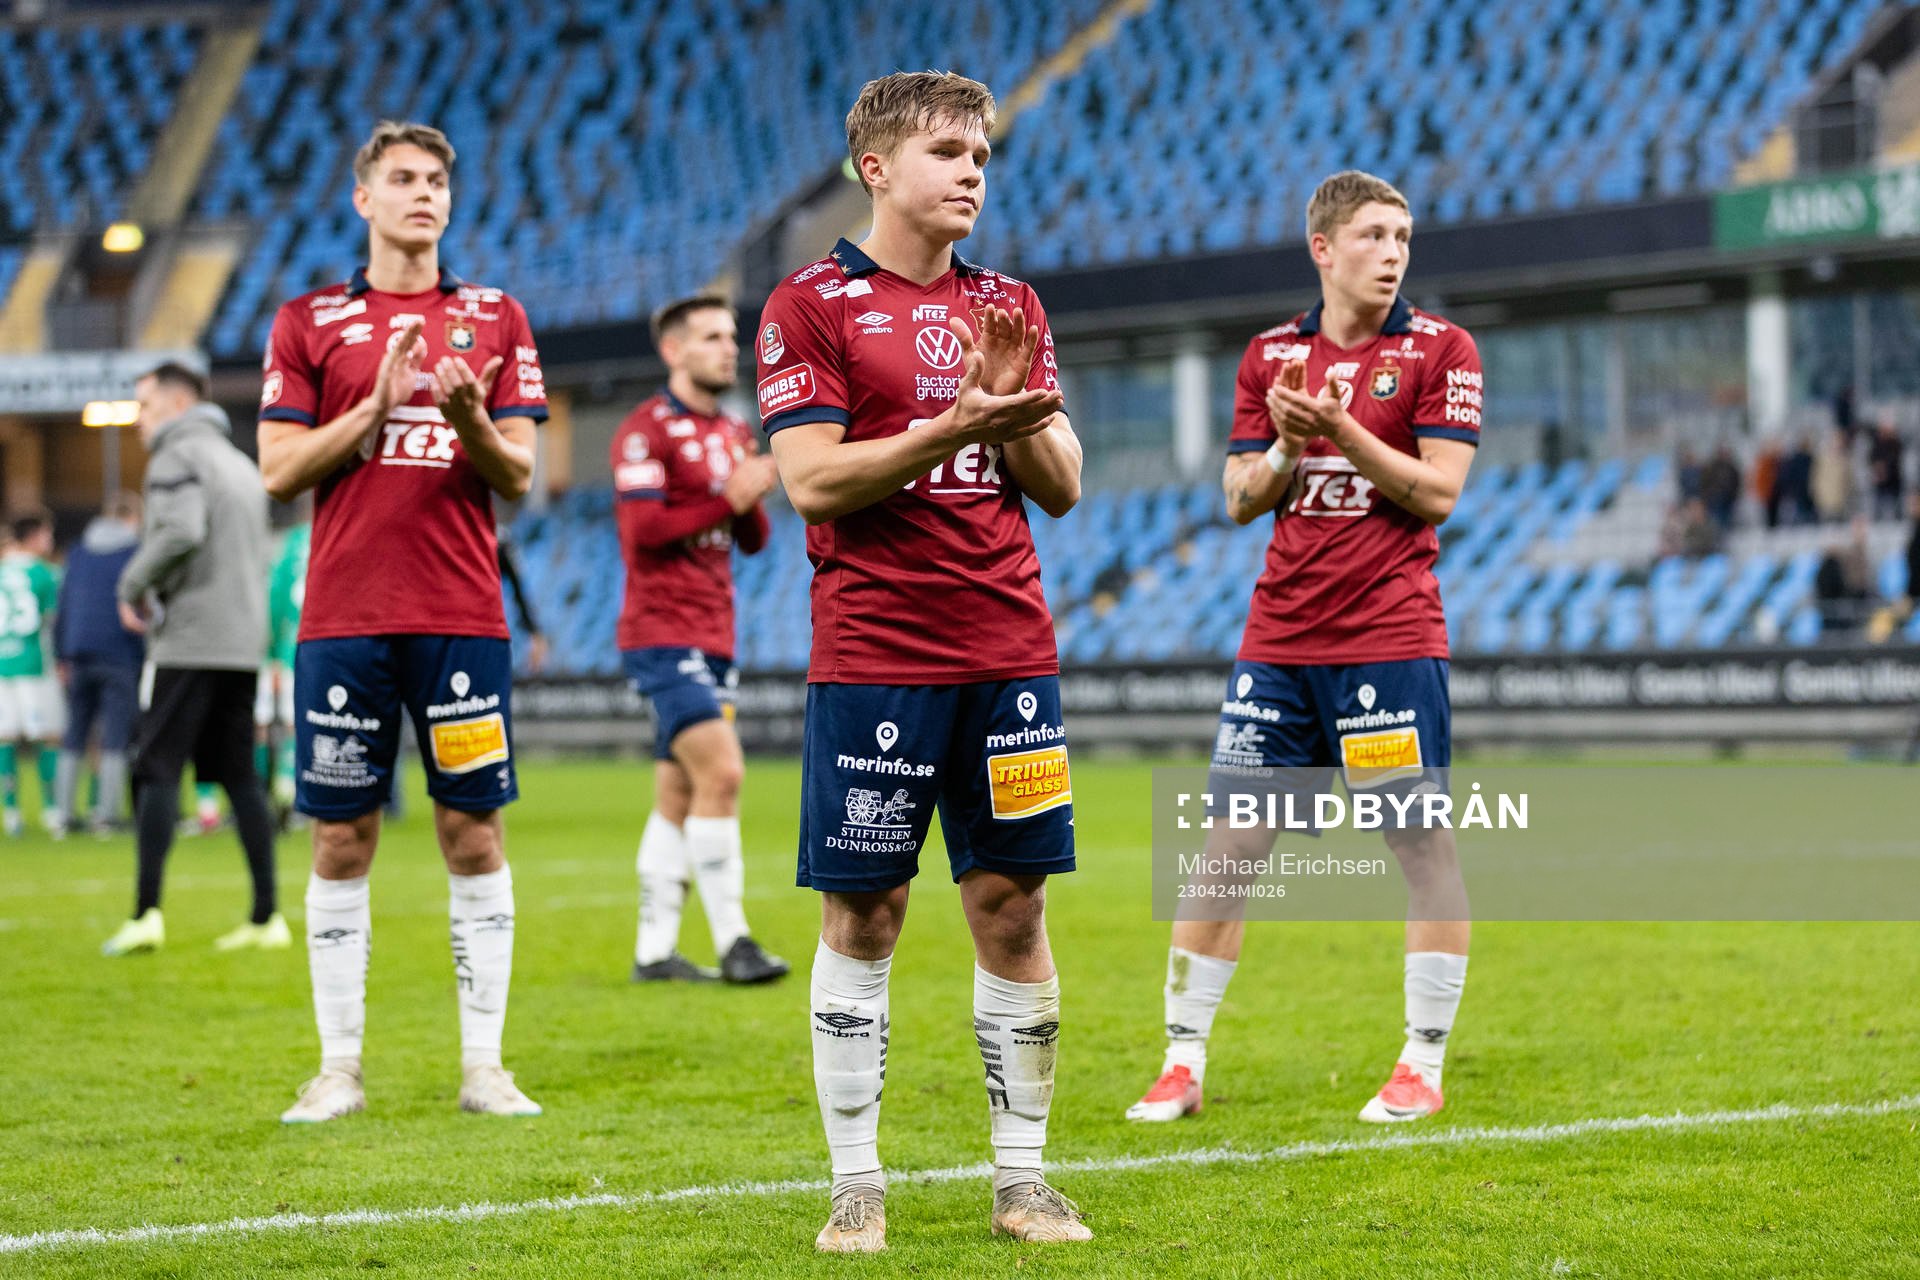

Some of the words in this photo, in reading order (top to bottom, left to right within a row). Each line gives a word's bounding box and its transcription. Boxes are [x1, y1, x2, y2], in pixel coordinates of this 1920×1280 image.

[912, 304, 949, 322] NTEX
[863, 326, 893, 335] umbro
[760, 371, 807, 402] UNIBET
[1336, 709, 1416, 731] merinfo.se
[987, 723, 1065, 748] merinfo.se
[837, 754, 935, 777] merinfo.se
[997, 757, 1065, 784] TRIUMF
[1012, 779, 1062, 798] GLASS
[841, 827, 911, 840] STIFTELSEN
[826, 836, 917, 853] DUNROSS&CO
[815, 1025, 870, 1038] umbro
[1013, 1033, 1059, 1046] umbr
